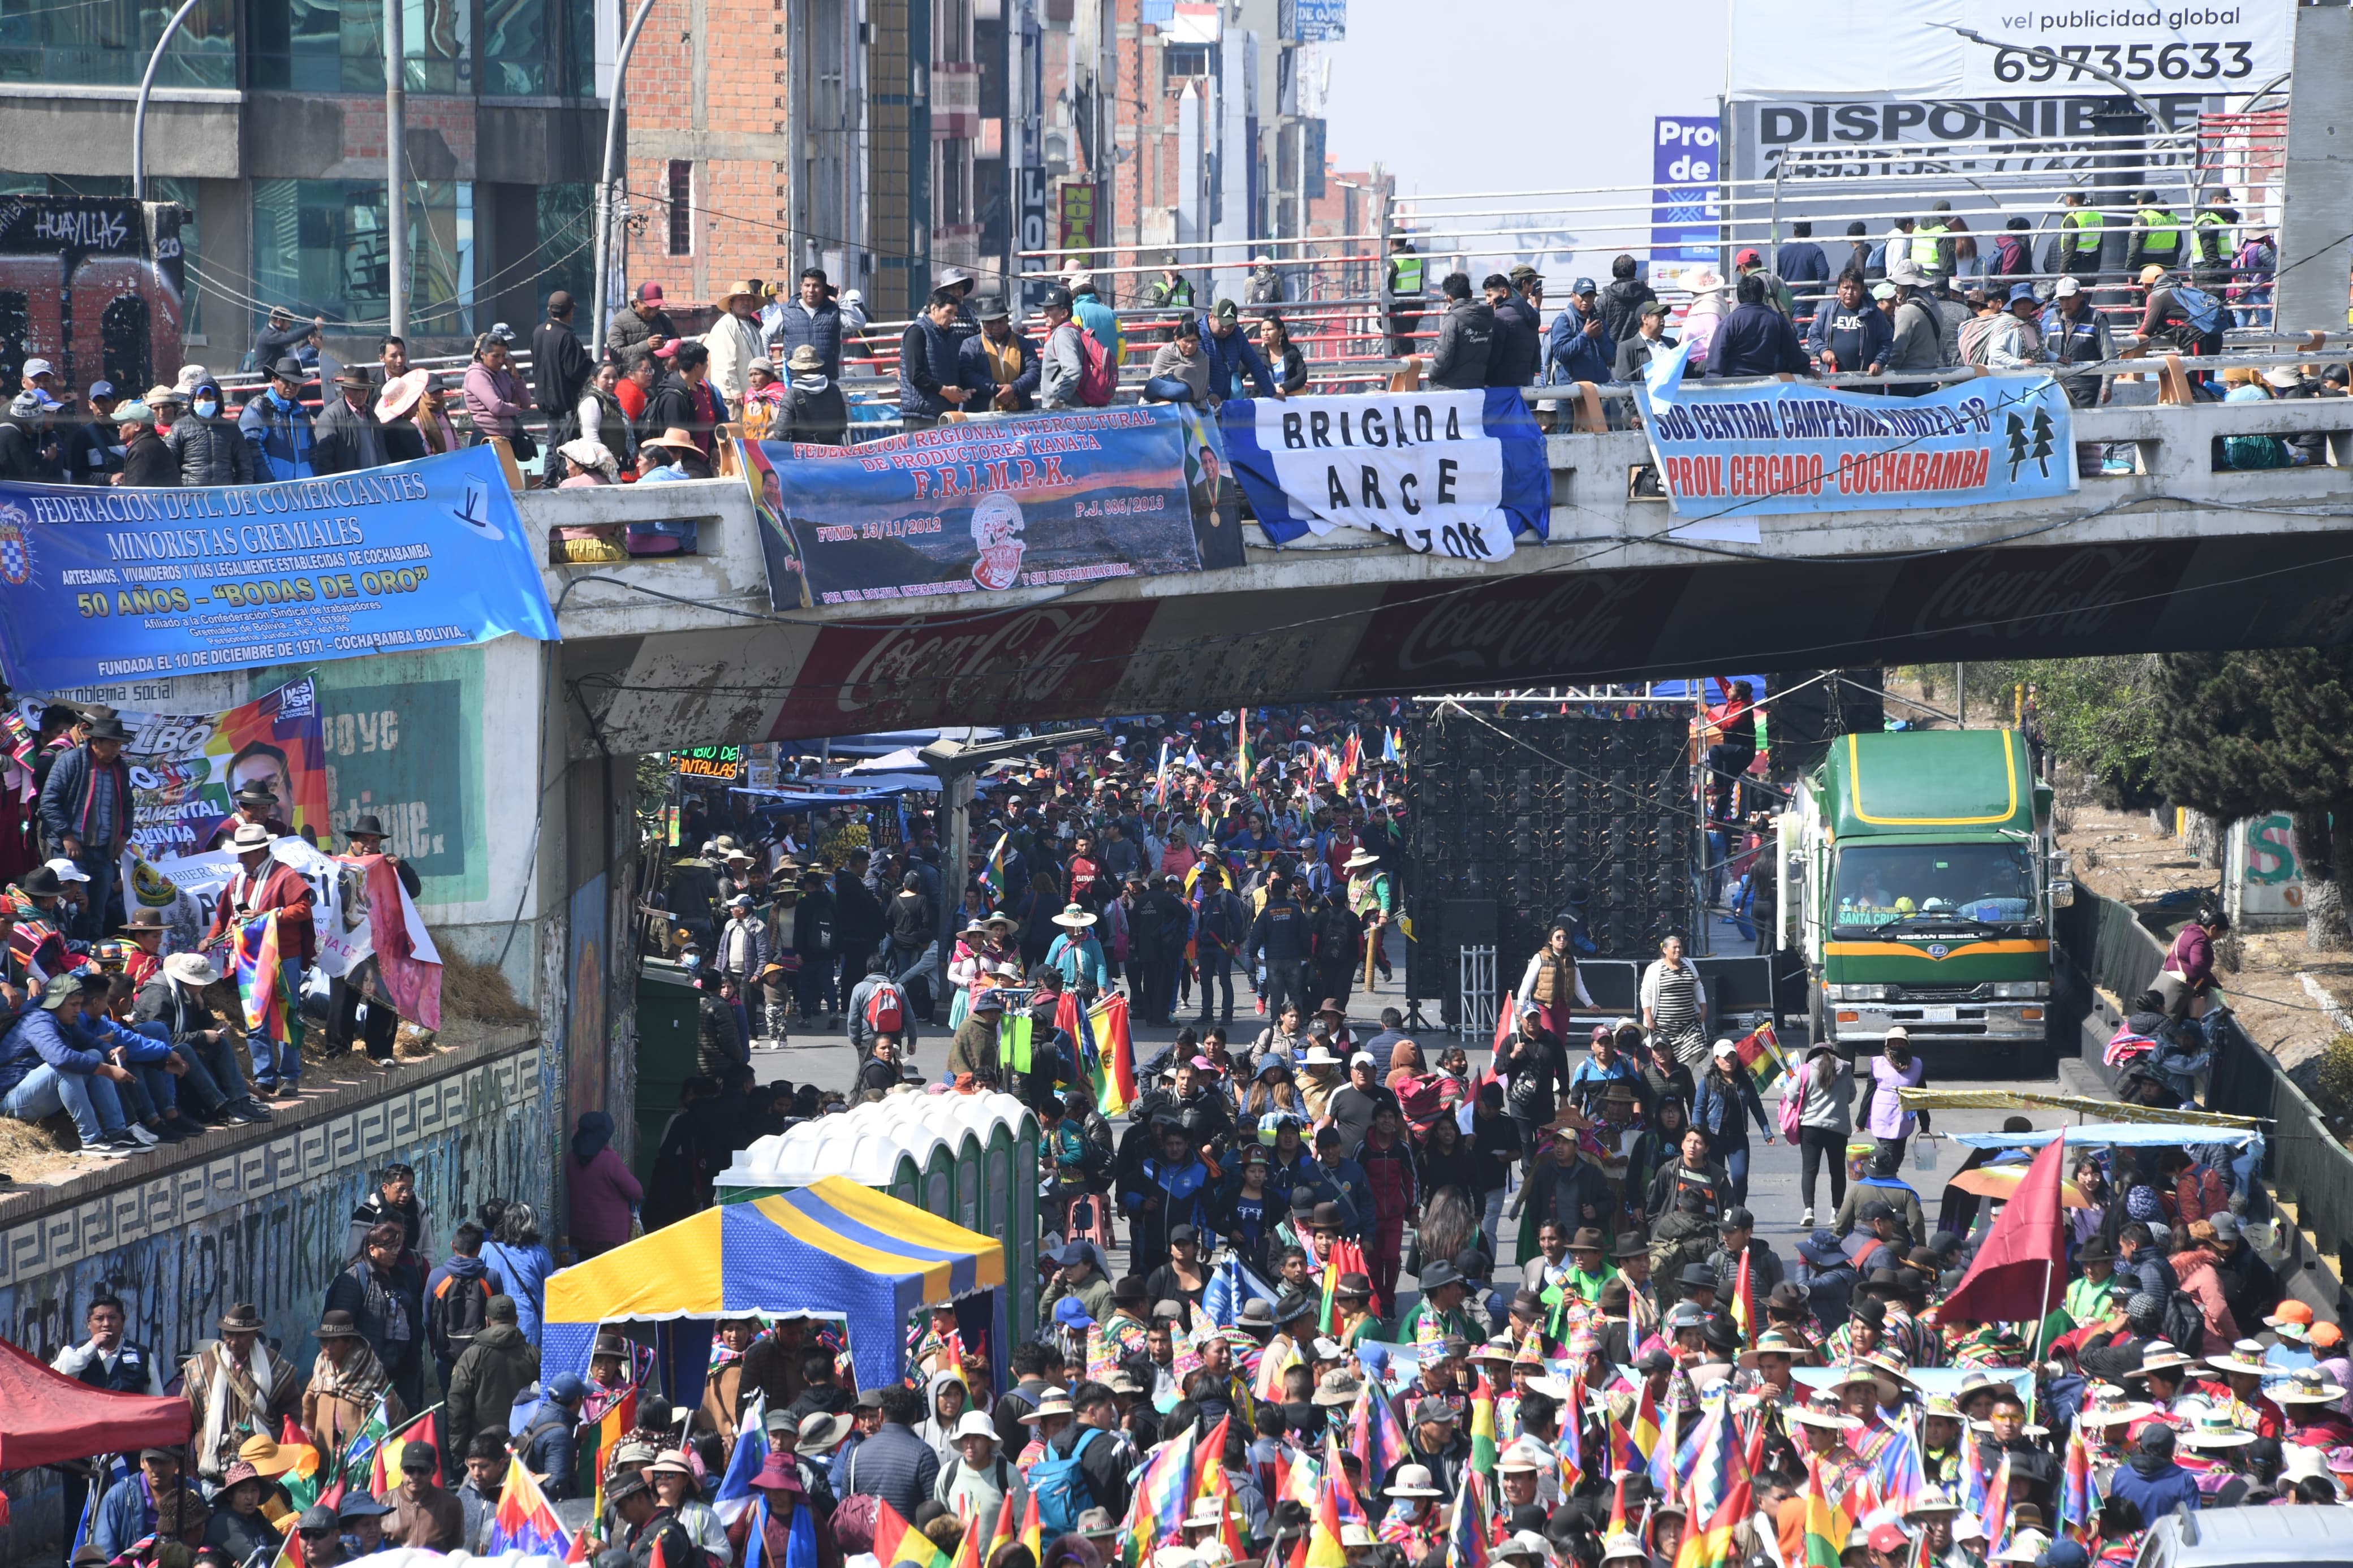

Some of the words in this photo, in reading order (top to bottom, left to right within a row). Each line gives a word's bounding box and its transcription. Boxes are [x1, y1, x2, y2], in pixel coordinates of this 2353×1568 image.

[1298, 8, 1313, 20] DE
[1315, 8, 1346, 21] OJOS
[2001, 10, 2033, 29] vel
[2041, 8, 2161, 34] publicidad
[2168, 6, 2240, 32] global
[1993, 41, 2253, 84] 69735633
[1659, 120, 1718, 147] Pro
[1669, 154, 1710, 181] de
[35, 210, 127, 249] HUAYLLAS
[2152, 216, 2178, 226] POLICIA
[158, 237, 180, 260] 20
[914, 424, 1006, 448] REGIONAL
[1009, 411, 1156, 437] INTERCULTURAL
[1282, 405, 1463, 449] BRIGADA
[1653, 402, 1696, 440] SUB
[1691, 400, 1779, 440] CENTRAL
[1777, 399, 1890, 439] CAMPESINA
[860, 459, 890, 472] DE
[891, 440, 1026, 469] PRODUCTORES
[1029, 435, 1101, 455] KANATA
[911, 456, 1073, 499] F.R.I.M.P.K.
[1666, 455, 1725, 497] PROV.
[1731, 454, 1822, 496] CERCADO
[1839, 448, 1990, 494] COCHABAMBA
[29, 491, 162, 524] FEDERACIÓN
[162, 491, 223, 520] DPTL.
[225, 488, 256, 516] DE
[258, 472, 428, 513] COMERCIANTES
[1327, 459, 1458, 515] ARCE
[1076, 502, 1102, 517] P.J.
[1105, 495, 1164, 515] 886/2013
[106, 527, 239, 560] MINORISTAS
[241, 516, 364, 554] GREMIALES
[817, 525, 857, 542] FUND.
[863, 517, 942, 539] 13/11/2012
[62, 569, 120, 586] ARTESANOS,
[123, 564, 181, 582] VIVANDEROS
[182, 564, 190, 578] Y
[192, 560, 214, 577] VÍAS
[216, 557, 276, 577] LEGALMENTE
[277, 551, 346, 573] ESTABLECIDAS
[349, 550, 363, 566] DE
[363, 543, 432, 565] COCHABAMBA
[1022, 573, 1029, 585] Y
[1031, 571, 1046, 585] SIN
[77, 591, 110, 618] 50
[117, 585, 190, 616] AÑOS
[318, 574, 359, 599] DE
[822, 591, 843, 604] POR
[842, 589, 863, 602] UNA
[863, 586, 900, 599] BOLIVIA
[900, 579, 976, 597] INTERCULTURAL
[144, 619, 181, 630] Afiliado
[189, 616, 199, 626] la
[200, 611, 270, 625] Confederación
[271, 604, 309, 620] Sindical
[309, 604, 322, 616] de
[322, 600, 382, 615] trabajadores
[189, 625, 238, 638] Gremiales
[239, 624, 253, 634] de
[253, 621, 286, 632] Bolivia
[98, 656, 154, 676] FUNDADA
[157, 654, 173, 669] EL
[175, 653, 189, 668] 10
[192, 651, 209, 666] DE
[210, 643, 275, 664] DICIEMBRE
[277, 642, 294, 656] DE
[296, 638, 324, 655] 1971
[334, 628, 415, 651] COCHABAMBA
[415, 625, 466, 643] BOLIVIA.
[133, 679, 174, 701] social
[721, 746, 738, 761] DE
[133, 799, 225, 822] TAMENTAL
[126, 825, 196, 845] OLIVIA
[163, 863, 231, 882] OBIERNO
[1839, 913, 1871, 925] SANTA
[1873, 913, 1901, 925] CRUZ
